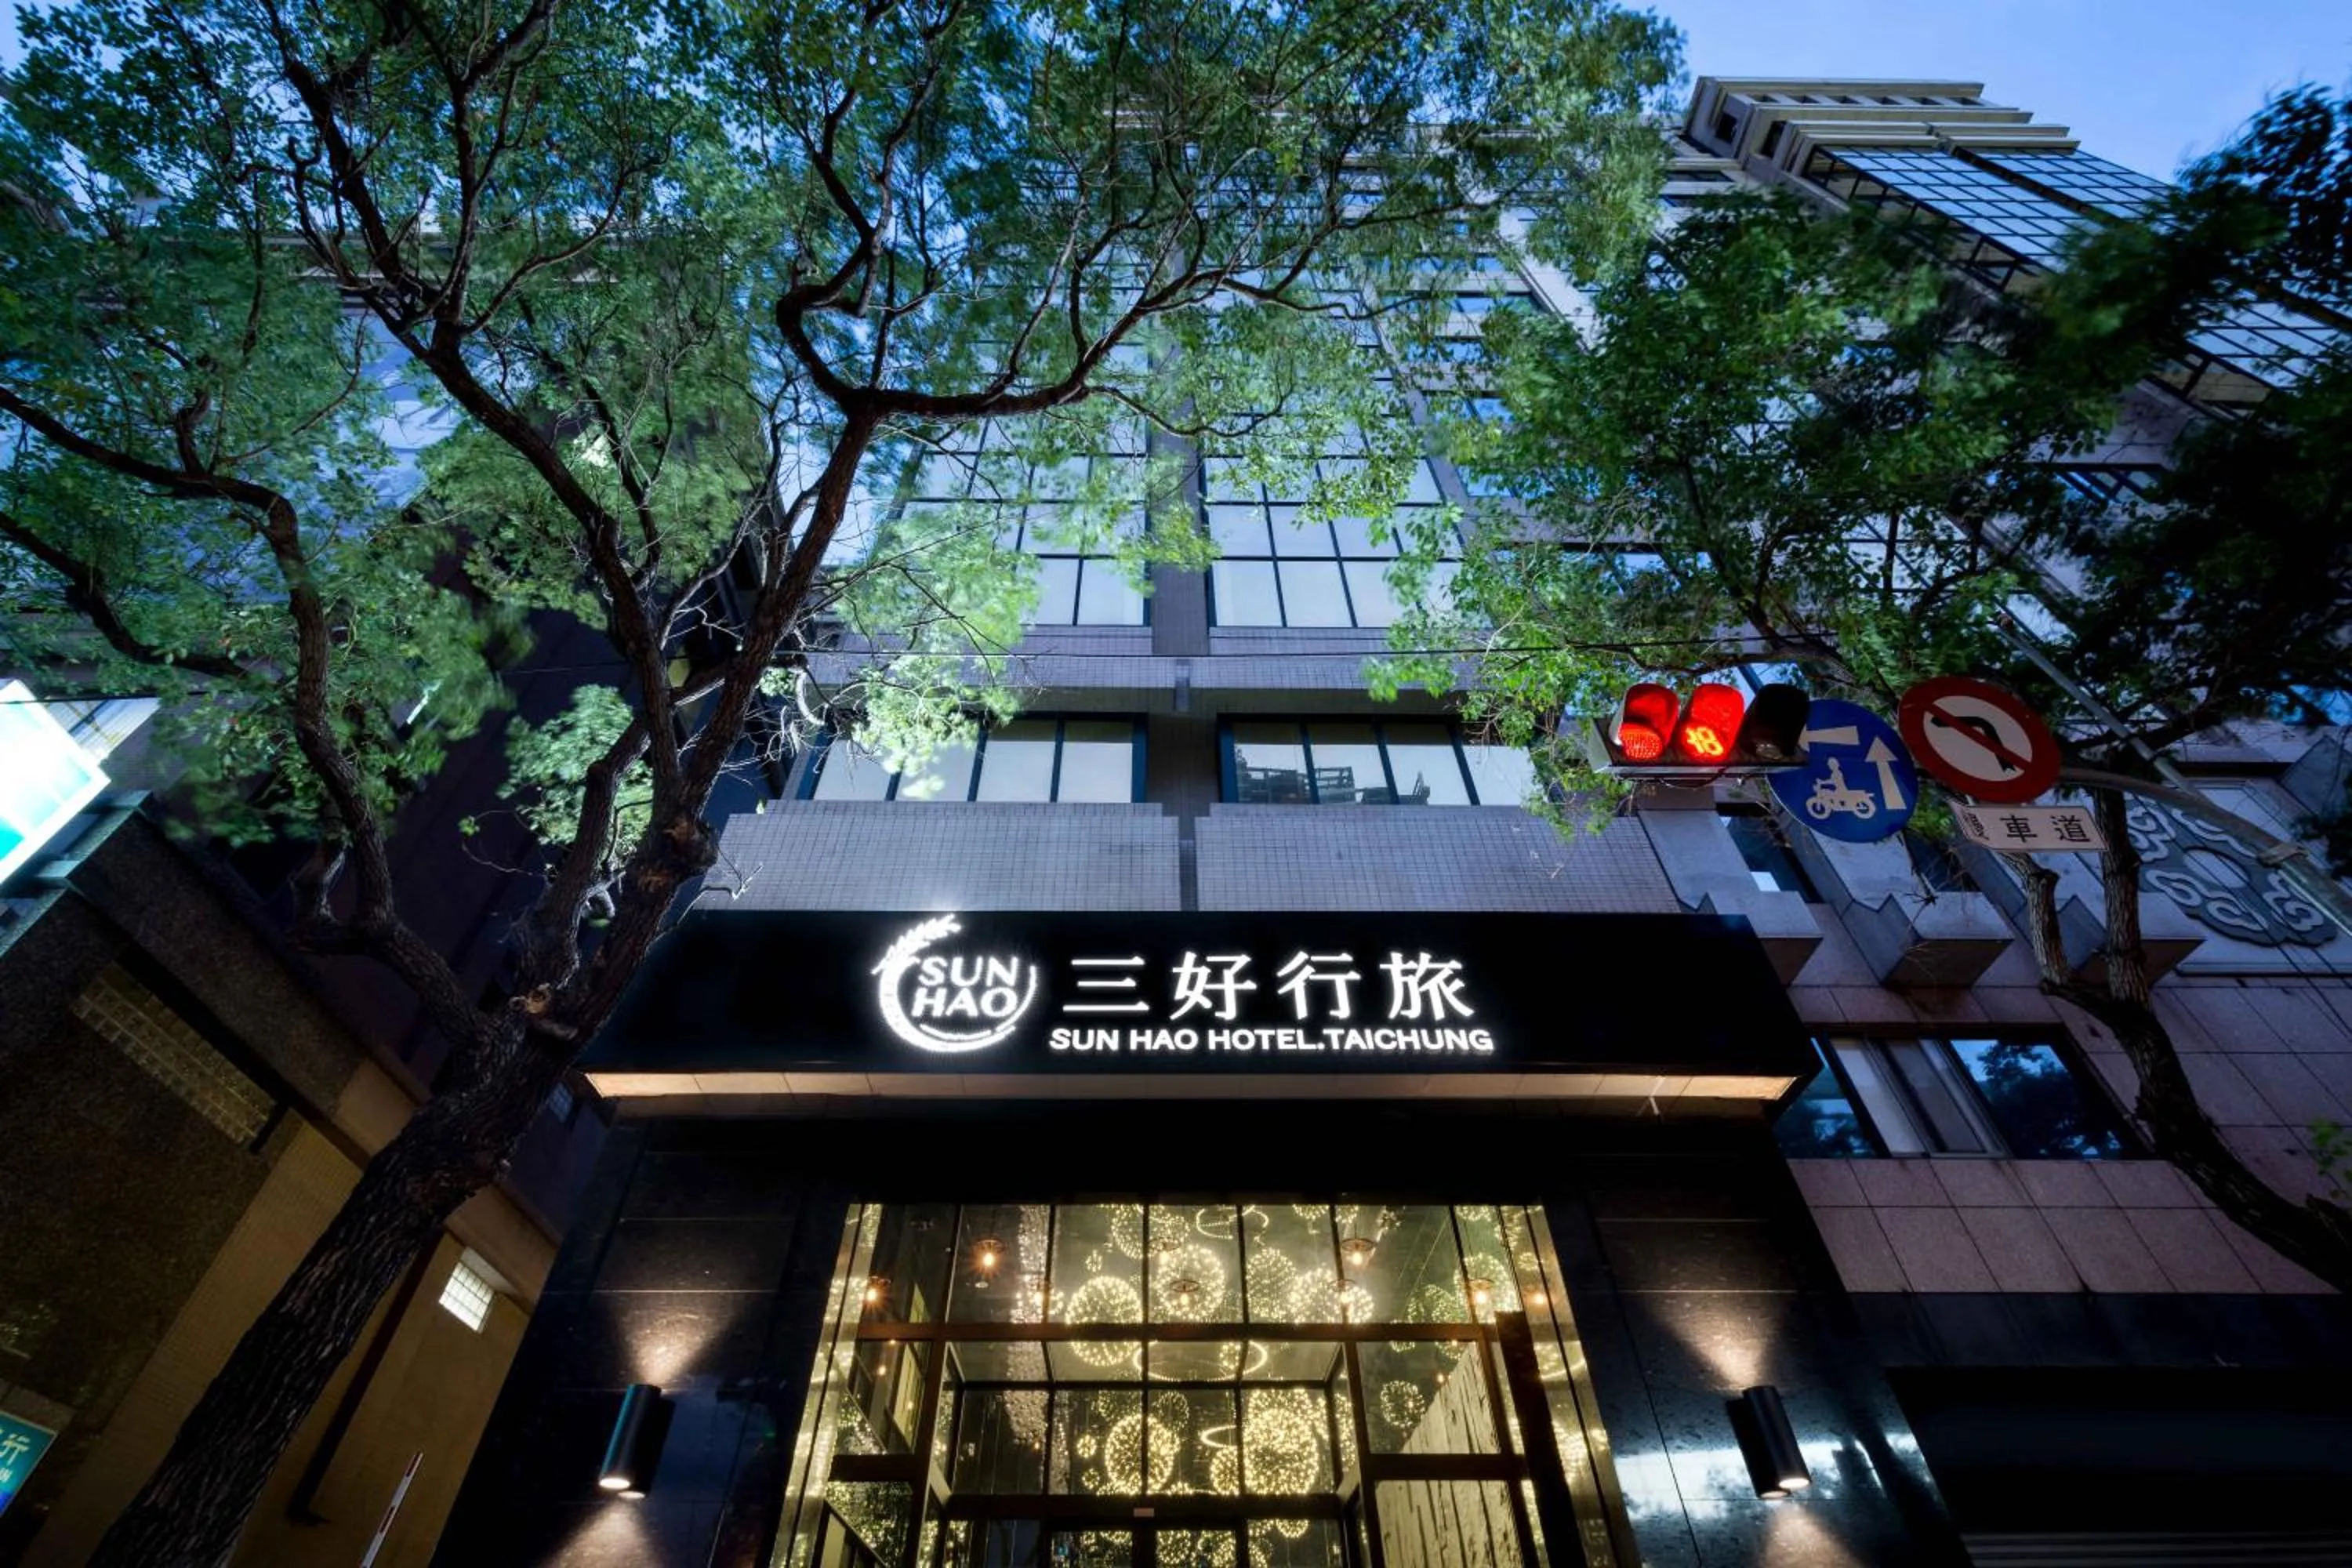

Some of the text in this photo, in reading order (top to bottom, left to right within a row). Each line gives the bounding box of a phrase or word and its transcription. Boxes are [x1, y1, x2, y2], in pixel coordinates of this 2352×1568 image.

[918, 955, 1019, 987] SUN
[1062, 951, 1475, 1020] 三好行旅
[911, 986, 1018, 1018] HAO
[1049, 1028, 1120, 1051] SUN
[1129, 1028, 1199, 1051] HAO
